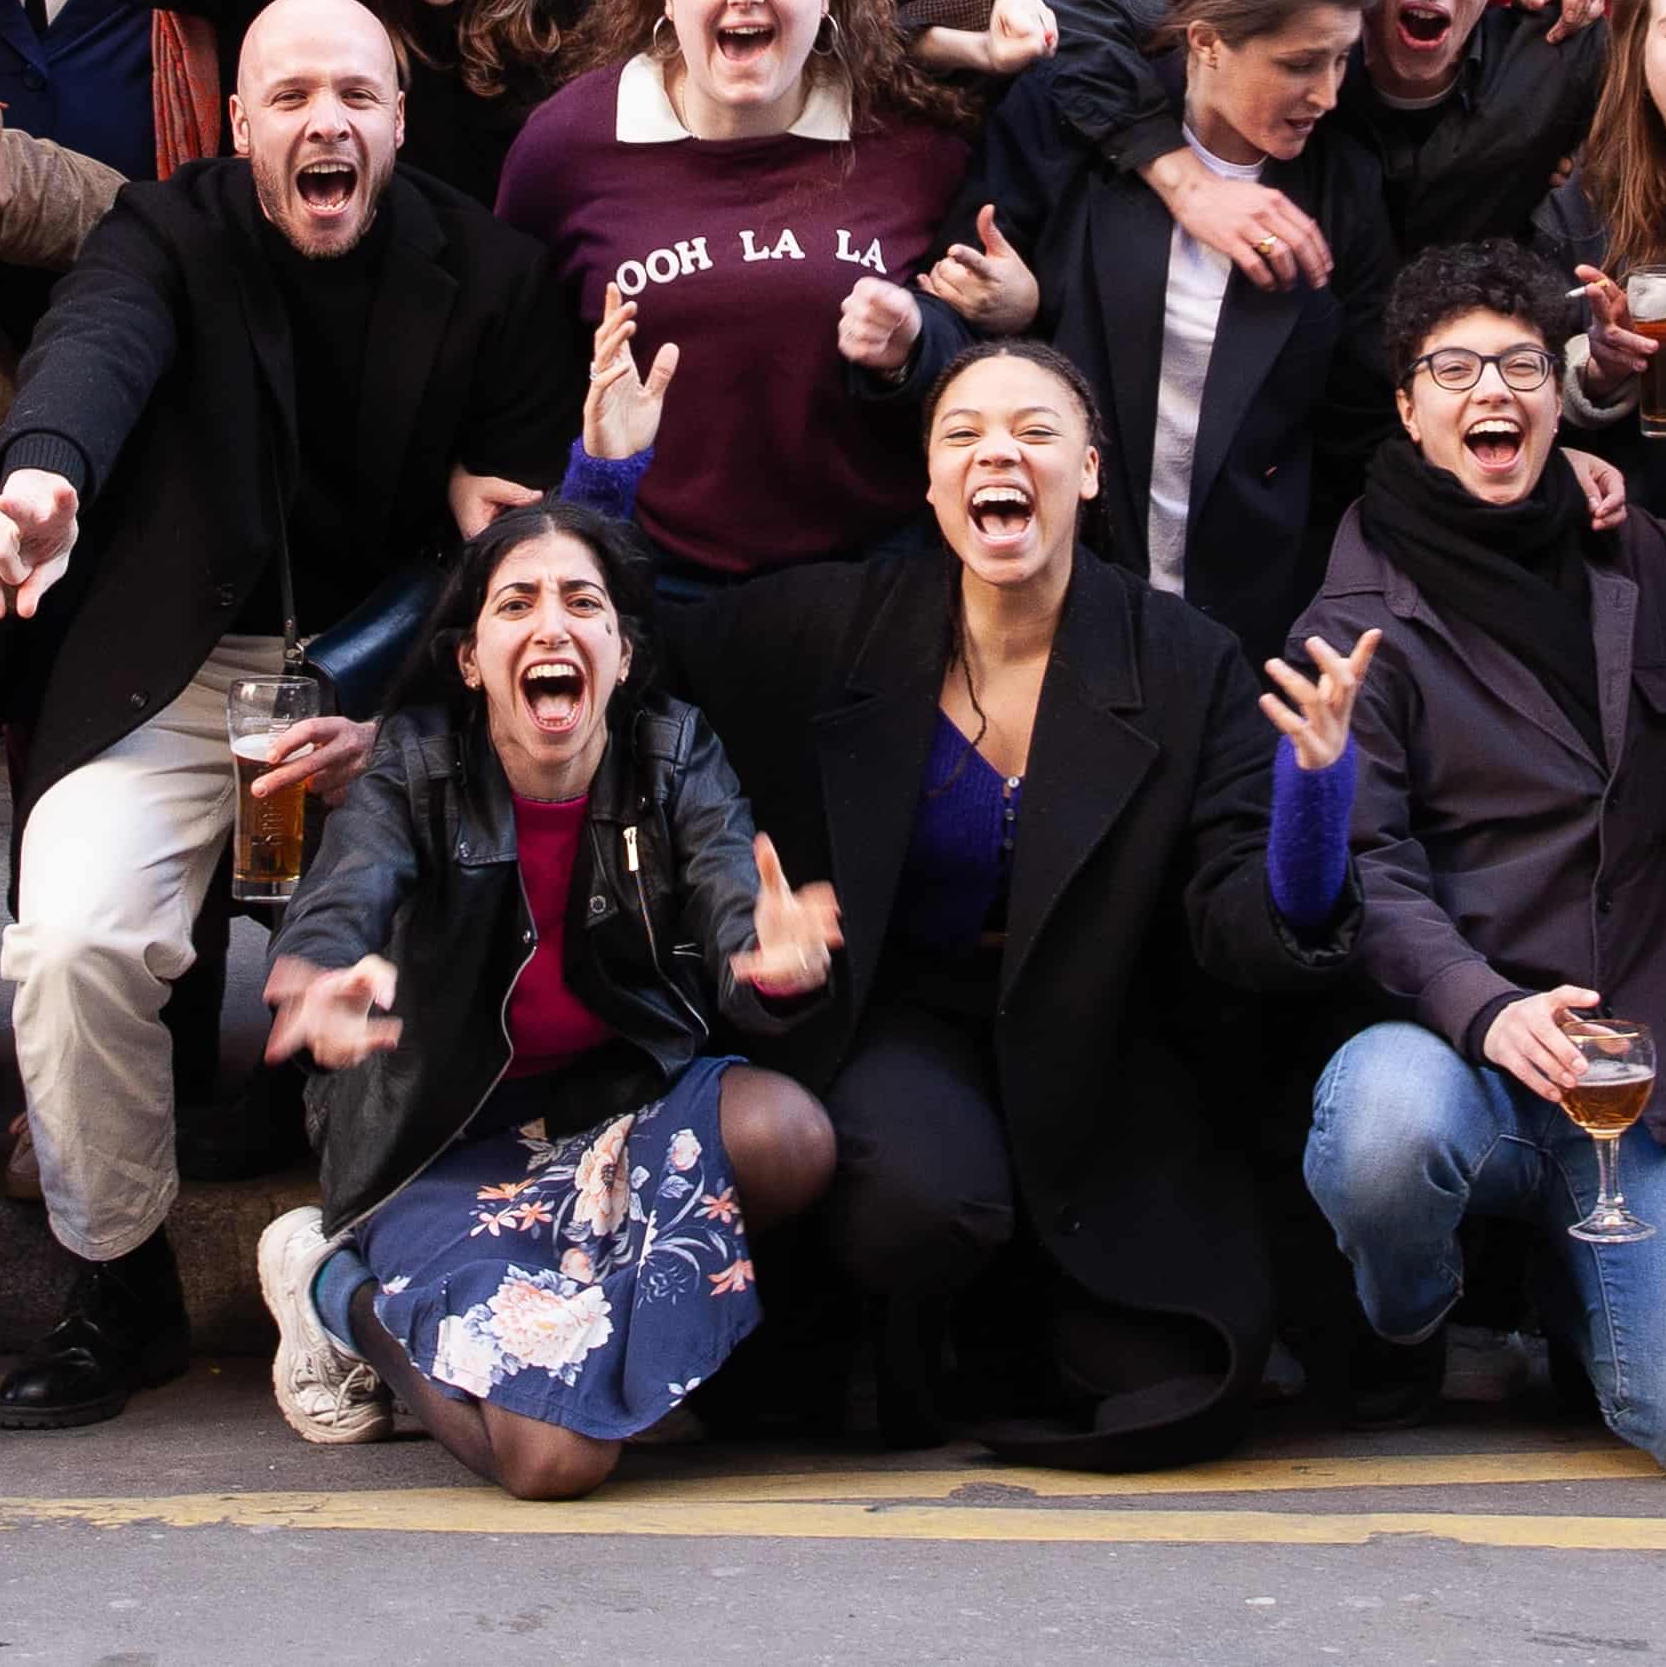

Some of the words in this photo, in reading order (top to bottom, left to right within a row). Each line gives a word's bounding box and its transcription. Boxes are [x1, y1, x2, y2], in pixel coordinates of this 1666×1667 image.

[615, 236, 713, 296] OOH
[738, 228, 806, 263] LA
[835, 229, 887, 275] LA
